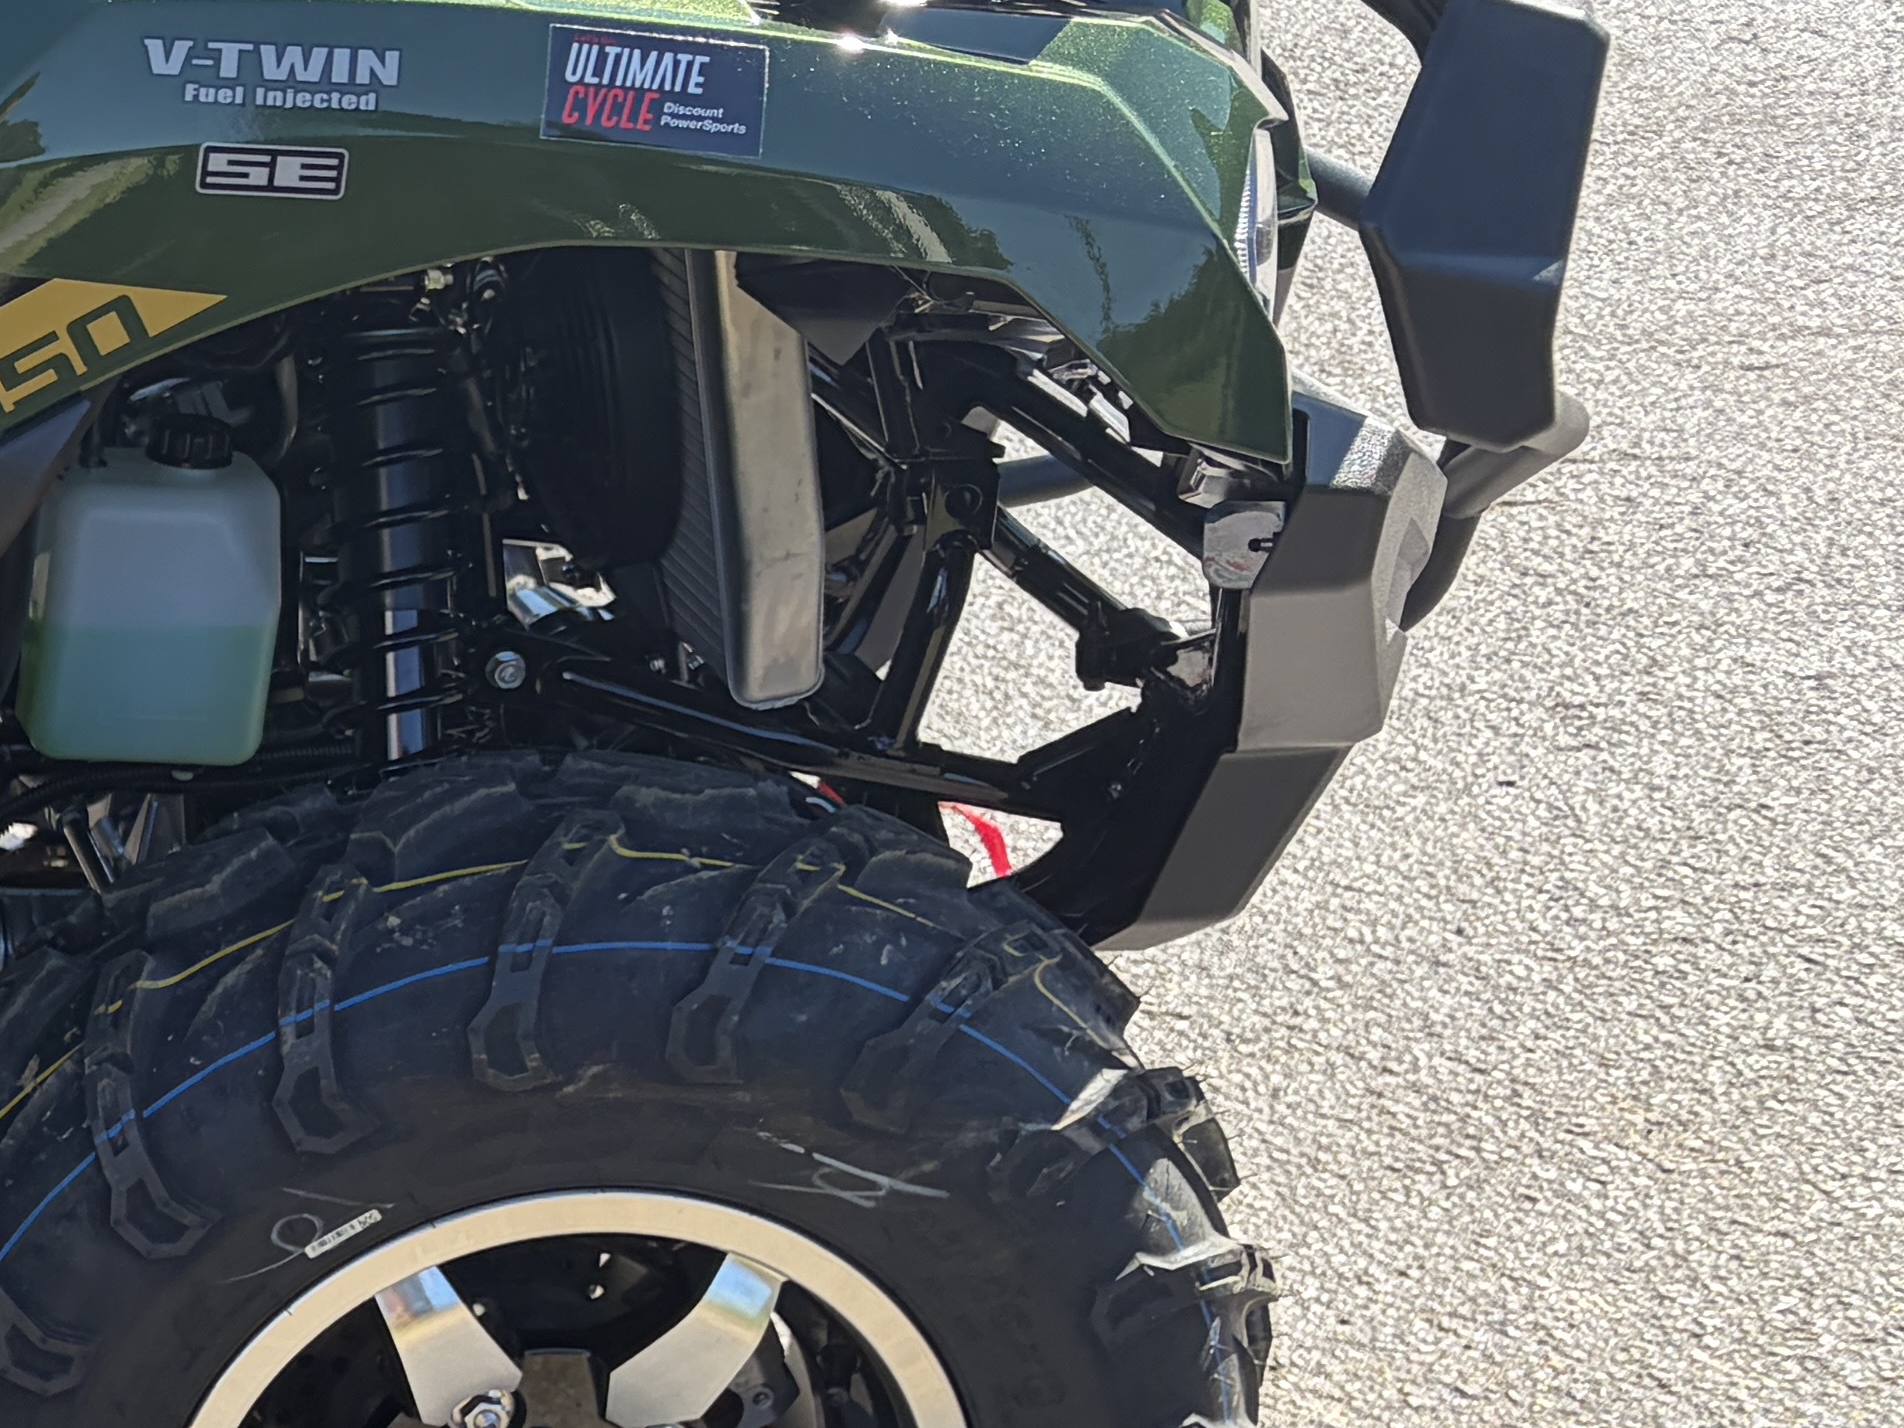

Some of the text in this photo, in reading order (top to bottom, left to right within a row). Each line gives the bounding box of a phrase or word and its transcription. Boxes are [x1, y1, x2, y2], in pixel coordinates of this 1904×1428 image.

[143, 37, 400, 87] V-TWIN
[564, 42, 711, 95] ULTIMATE
[184, 83, 377, 111] Fuel Injected
[561, 84, 661, 132] CYCLE
[663, 102, 724, 118] Discount
[660, 115, 747, 134] PowerSports
[205, 152, 340, 190] SE
